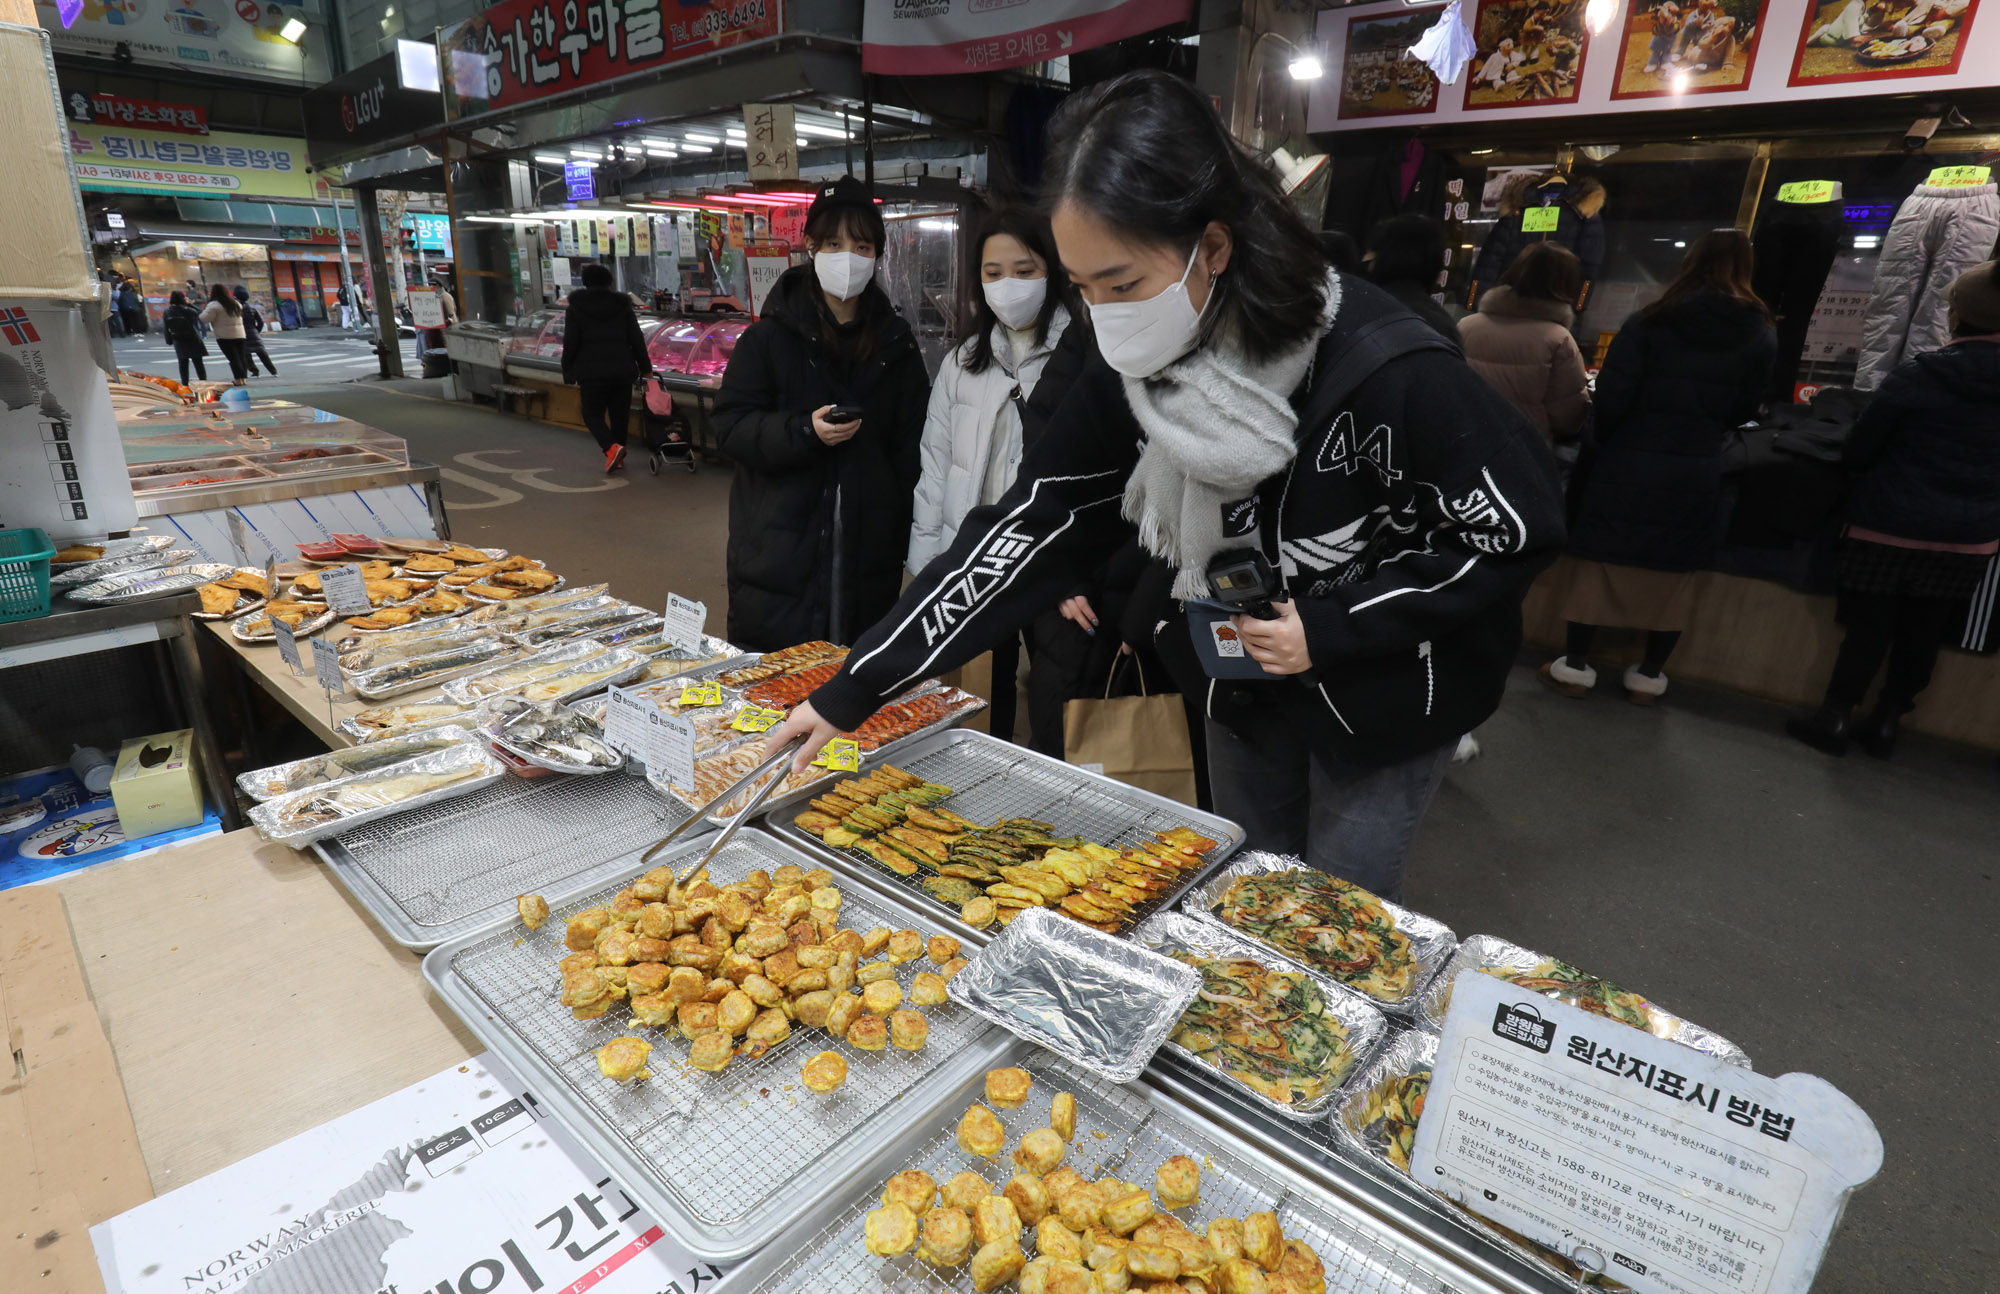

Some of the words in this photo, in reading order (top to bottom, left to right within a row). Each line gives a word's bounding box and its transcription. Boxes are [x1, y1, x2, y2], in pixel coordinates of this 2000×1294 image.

[964, 43, 1001, 67] 지하로
[1006, 33, 1050, 58] 오세요
[94, 100, 197, 128] 비상소화전
[1228, 500, 1252, 522] KANGOL
[1496, 1023, 1548, 1049] 월드컵시장
[1505, 1014, 1545, 1037] 망원동
[1474, 1080, 1528, 1107] 국산농수산물은
[1571, 1122, 1596, 1137] 생산된
[1477, 1067, 1532, 1094] 수입농수산물은
[1481, 1054, 1520, 1075] 포장제품은
[1622, 1113, 1648, 1128] 용기나
[1680, 1136, 1736, 1164] 원산지표시를
[1565, 1034, 1719, 1112] 원산지표시
[1724, 1096, 1794, 1141] 방법
[1456, 1110, 1490, 1130] 원산지
[1493, 1126, 1551, 1159] 부정신고는
[1556, 1156, 1632, 1195] 1588-8112로
[1636, 1191, 1704, 1227] 연락주시기
[1707, 1223, 1766, 1254] 바랍니다
[1457, 1146, 1494, 1167] 유도하여
[1496, 1164, 1534, 1186] 생산자와
[1537, 1183, 1576, 1207] 소비자를
[1580, 1203, 1621, 1227] 보호하기
[1624, 1224, 1645, 1239] 위해
[1648, 1235, 1693, 1260] 시행하고
[1696, 1257, 1743, 1283] 있습니다
[1460, 1135, 1535, 1175] 원산지표시제도는
[1538, 1172, 1577, 1194] 소비자의
[1579, 1191, 1621, 1216] 알권리를
[1673, 1234, 1708, 1256] 공정한
[1711, 1251, 1746, 1273] 거래를
[182, 1213, 312, 1290] NORWAY
[198, 1255, 273, 1294] ALTED
[276, 1200, 382, 1263] MACKEREL
